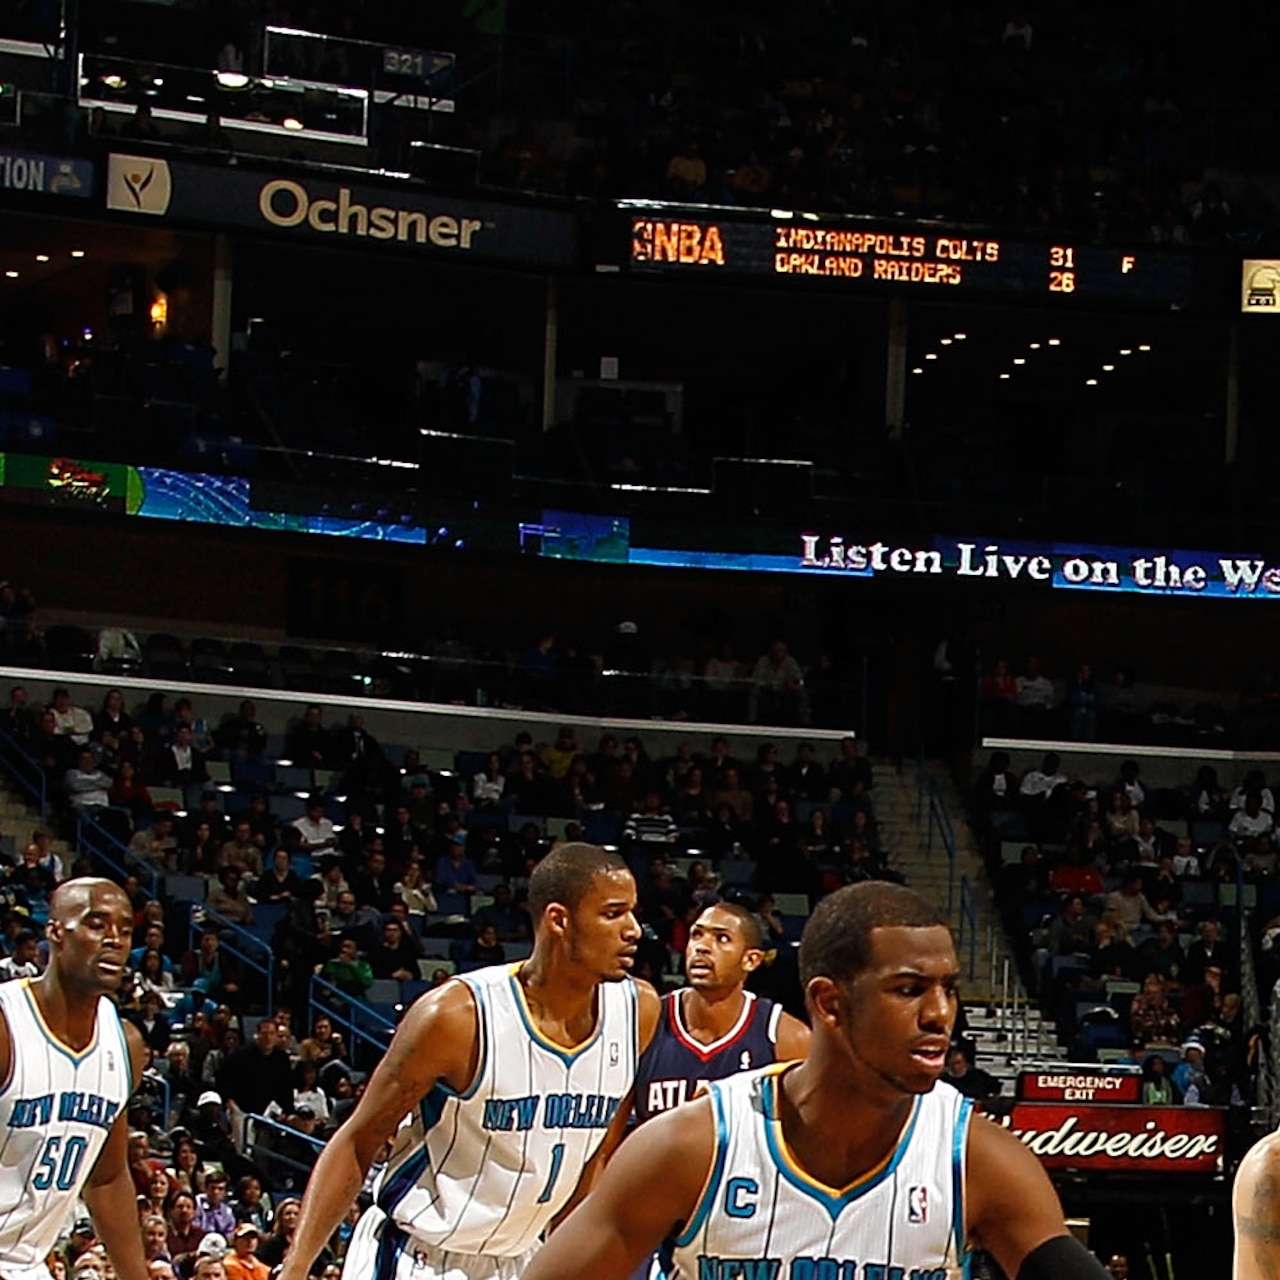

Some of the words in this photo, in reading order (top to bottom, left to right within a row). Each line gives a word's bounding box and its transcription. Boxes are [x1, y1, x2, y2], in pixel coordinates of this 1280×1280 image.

[258, 177, 483, 250] Ochsner
[653, 222, 725, 265] NBA
[775, 228, 926, 257] INDIANAPOLIS
[935, 239, 999, 262] COLTS
[1050, 247, 1074, 268] 31
[775, 253, 863, 278] OAKLAND
[873, 260, 962, 285] RAIDERS
[1049, 272, 1075, 292] 26
[800, 534, 943, 574] Listen
[956, 543, 1052, 580] Live
[1063, 557, 1119, 585] on
[1132, 555, 1207, 589] the
[1037, 1075, 1123, 1089] EMERGENCY
[1064, 1089, 1095, 1101] EXIT
[982, 1112, 1218, 1160] udweiser
[32, 1135, 87, 1192] 50
[724, 1176, 759, 1219] C
